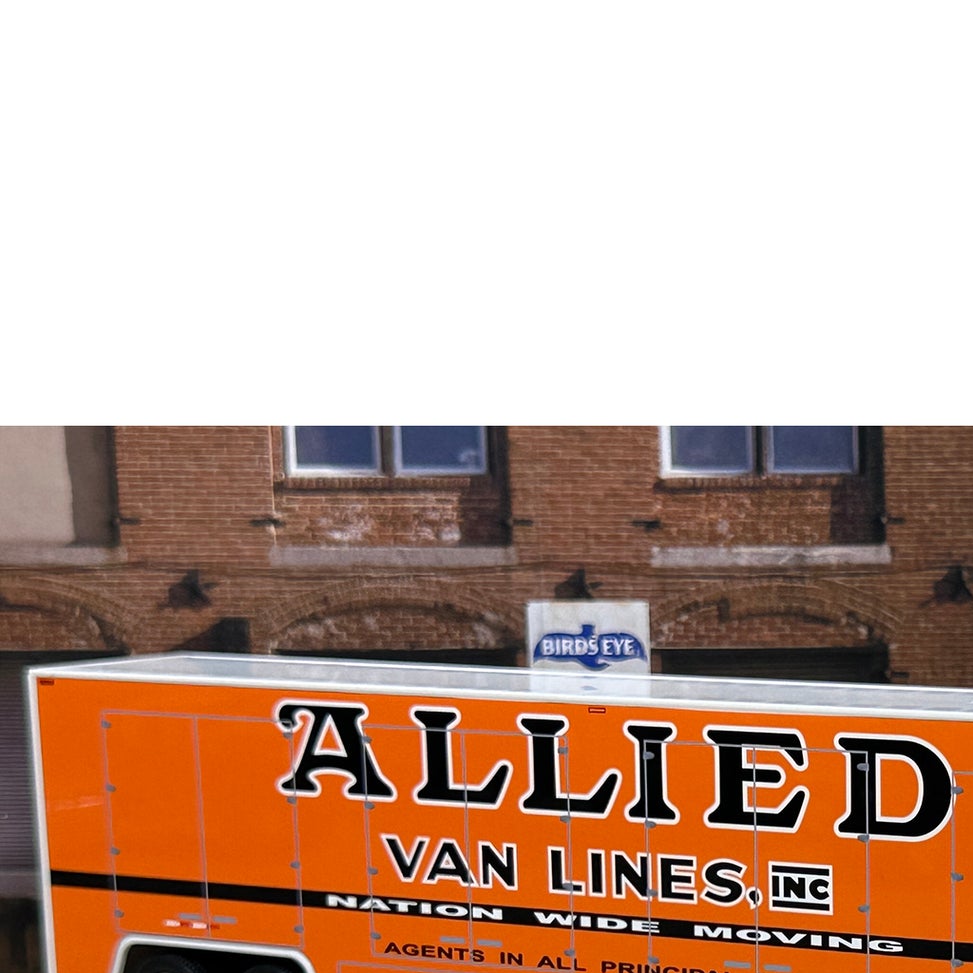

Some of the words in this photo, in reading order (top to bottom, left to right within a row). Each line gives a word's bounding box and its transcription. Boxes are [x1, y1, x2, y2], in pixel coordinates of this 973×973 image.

[542, 636, 599, 656] BIRDS
[602, 639, 635, 656] EYE
[276, 700, 953, 841] ALLIED
[382, 834, 518, 891] VAN
[548, 846, 763, 909] LINES,
[771, 876, 831, 900] INC
[325, 895, 504, 921] NATION
[535, 912, 660, 934] WIDE
[694, 924, 904, 953] MOVING
[384, 941, 485, 962] AGENTS
[500, 951, 523, 966] IN
[538, 956, 587, 972] ALL
